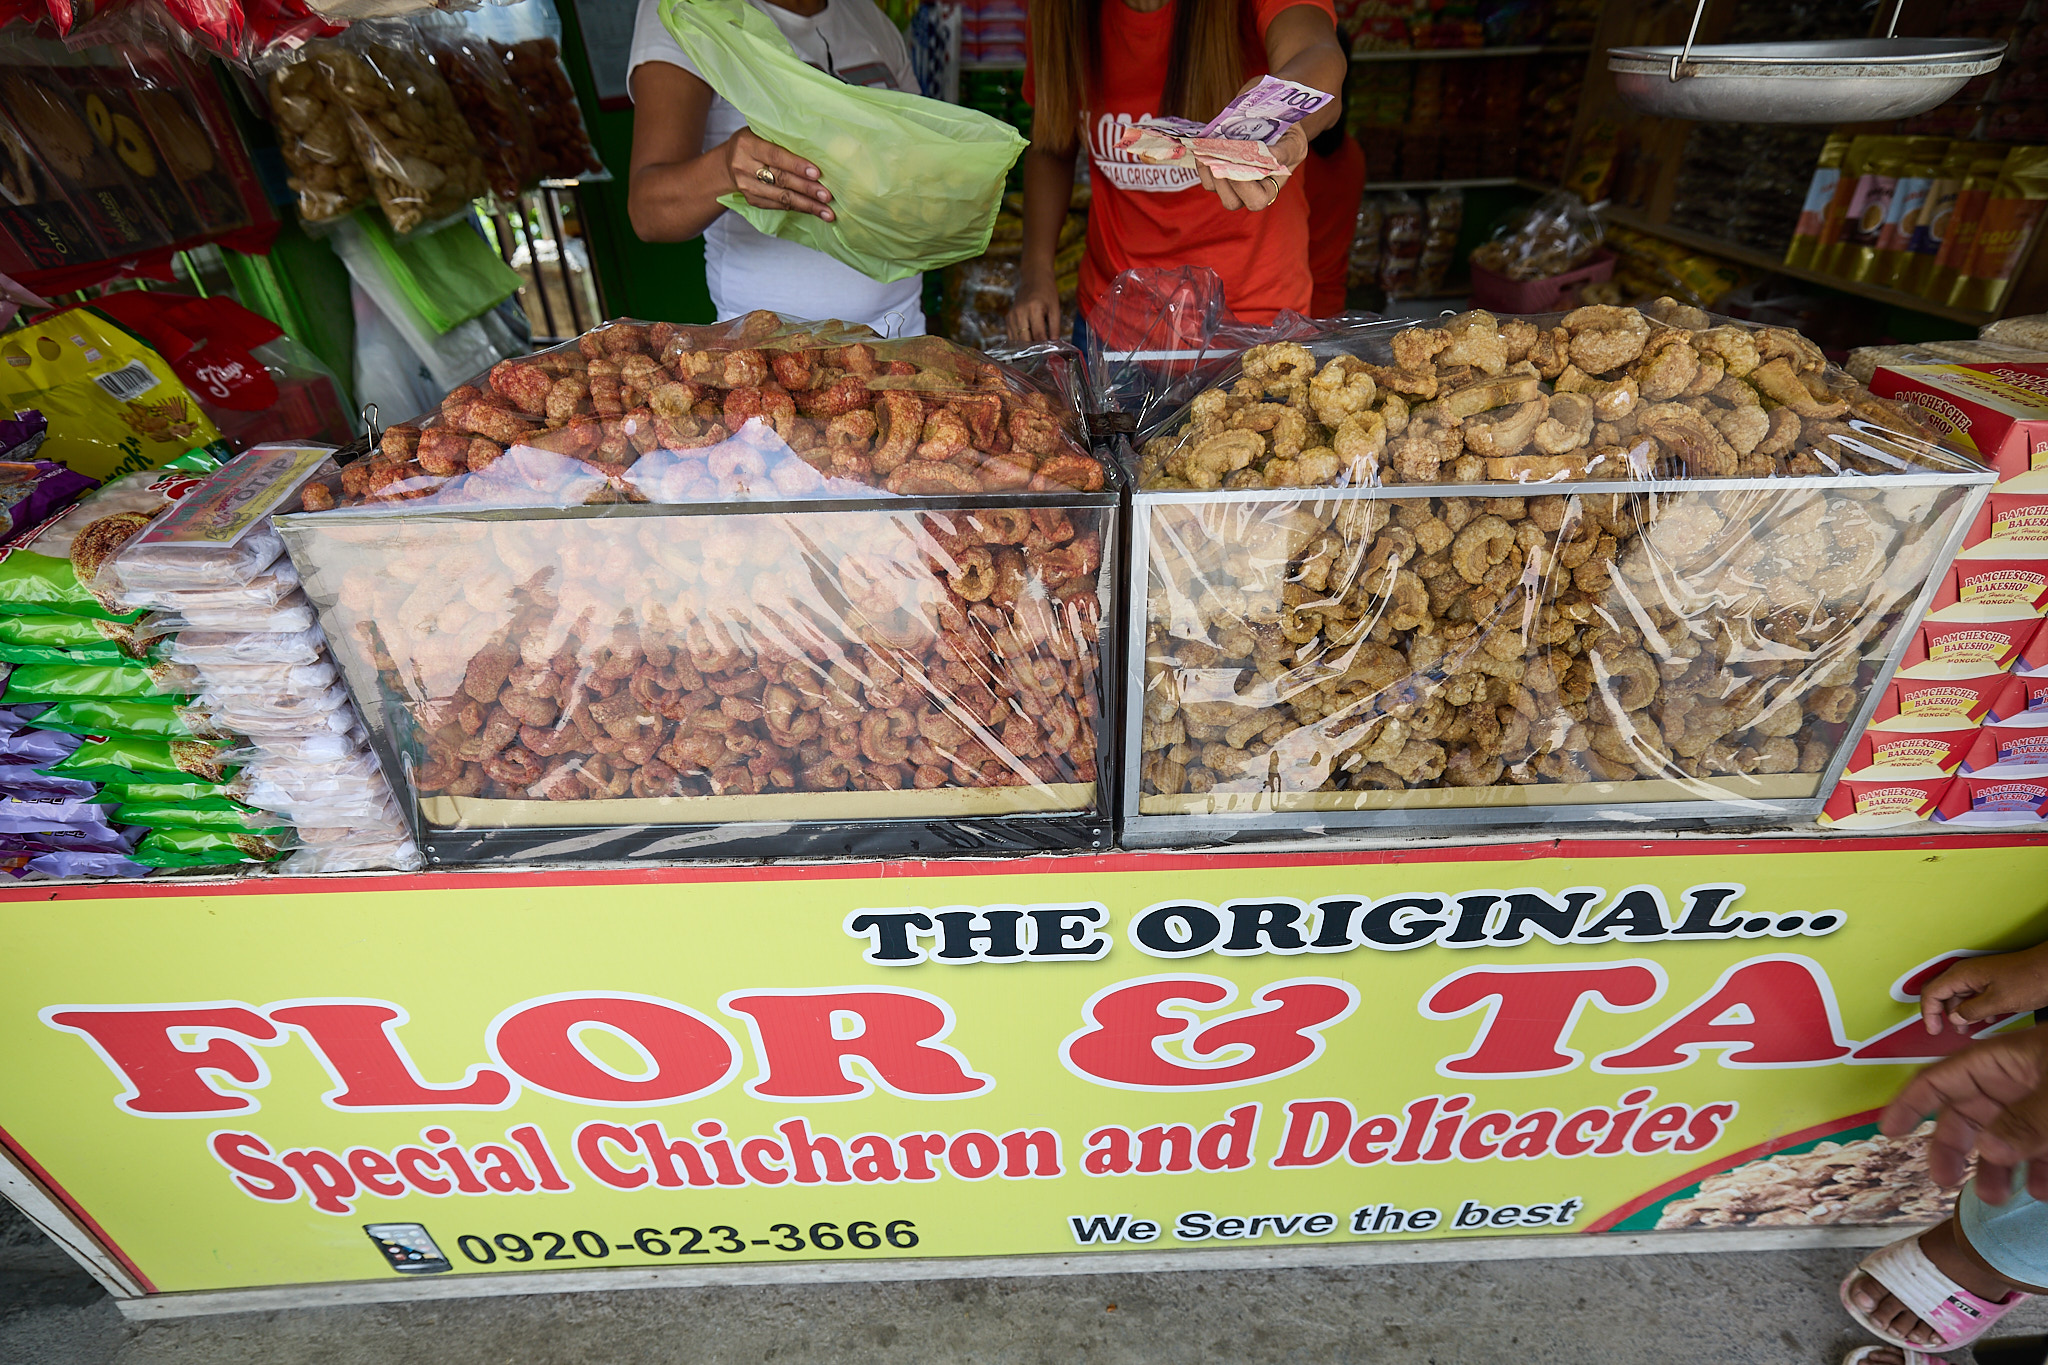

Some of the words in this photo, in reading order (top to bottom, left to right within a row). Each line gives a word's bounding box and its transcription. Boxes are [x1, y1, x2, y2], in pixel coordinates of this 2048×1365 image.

[1280, 88, 1322, 110] 100
[1127, 167, 1169, 186] CRISPY
[37, 217, 69, 254] OTAP
[1895, 391, 1972, 434] RAMCHESCHEL
[233, 458, 287, 502] OTAP
[1965, 569, 2045, 587] RAMCHESCHEL
[1975, 582, 2029, 594] BAKESHOP
[1933, 630, 2011, 647] RAMCHESCHEL
[1943, 642, 1995, 653] BAKESHOP
[1904, 686, 1979, 703] RAMCHESCHEL
[1914, 697, 1963, 708] BAKESHOP
[1878, 738, 1951, 753] RAMCHESCHEL
[1888, 748, 1935, 758] BAKESHOP
[1858, 787, 1929, 802] RAMCHESCHEL
[1977, 783, 2048, 798] RAMCHESCHEL
[1986, 793, 2034, 803] BAKESHOP
[1868, 797, 1913, 807] BAKESHOP
[850, 906, 1103, 962] THE
[48, 990, 990, 1113] FLOR
[1065, 977, 1352, 1087] &
[212, 1123, 574, 1214] Special
[575, 1118, 1062, 1190] Chicharon
[1084, 1104, 1262, 1176] and
[1275, 1089, 1736, 1168] Delicacies
[1069, 1215, 1158, 1244] We
[1175, 1211, 1336, 1240] Serve
[1351, 1204, 1439, 1233] the
[1454, 1197, 1579, 1231] best
[455, 1219, 920, 1266] 0920-623-3666
